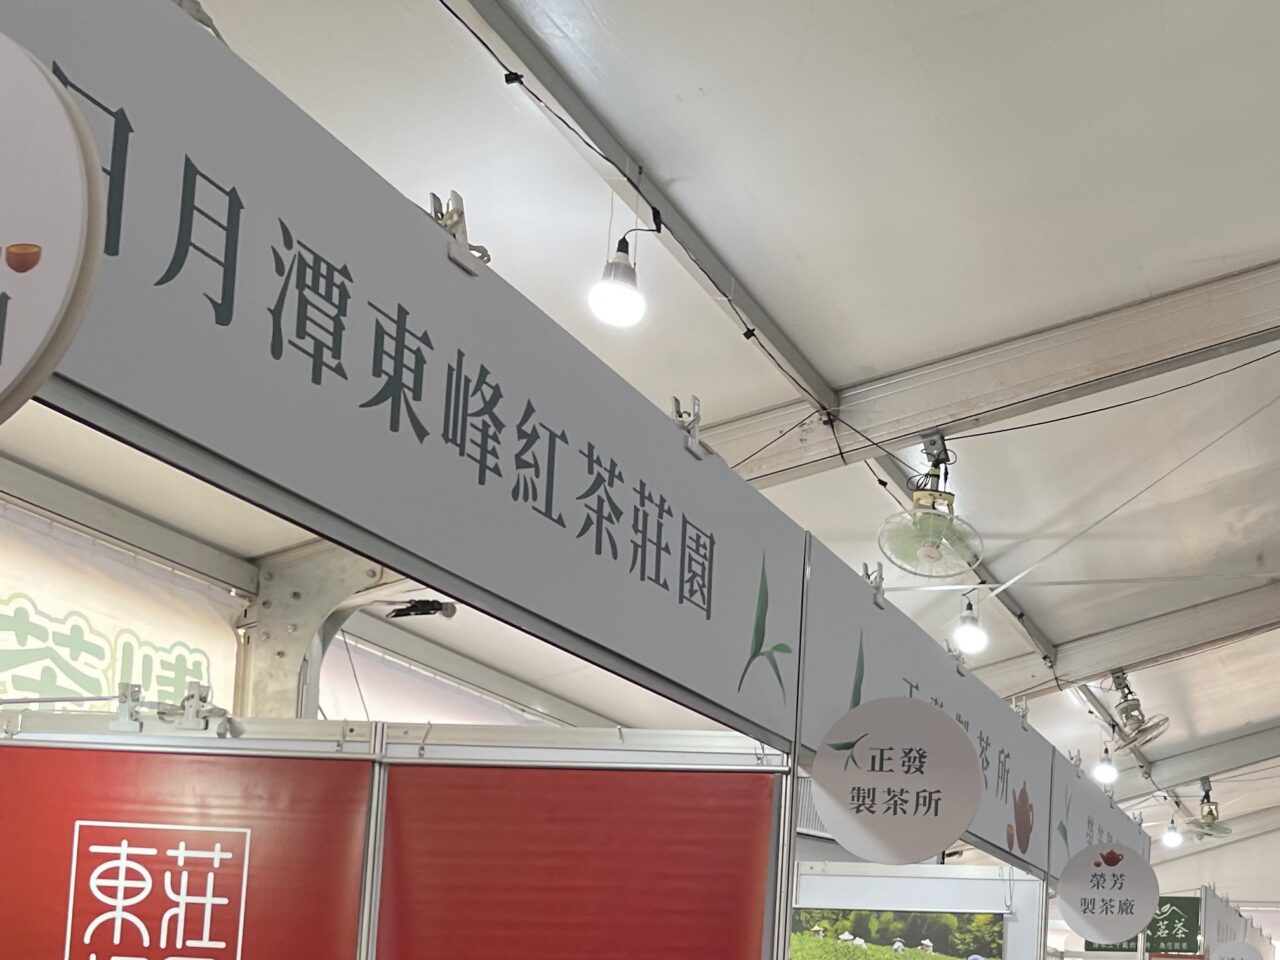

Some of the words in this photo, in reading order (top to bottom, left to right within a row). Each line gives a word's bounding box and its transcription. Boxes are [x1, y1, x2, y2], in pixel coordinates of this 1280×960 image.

[867, 746, 927, 775] 正發
[850, 786, 942, 817] 製茶所
[1089, 872, 1126, 890] 榮芳
[1080, 898, 1135, 915] 製茶廠
[1146, 918, 1189, 938] 茗茶
